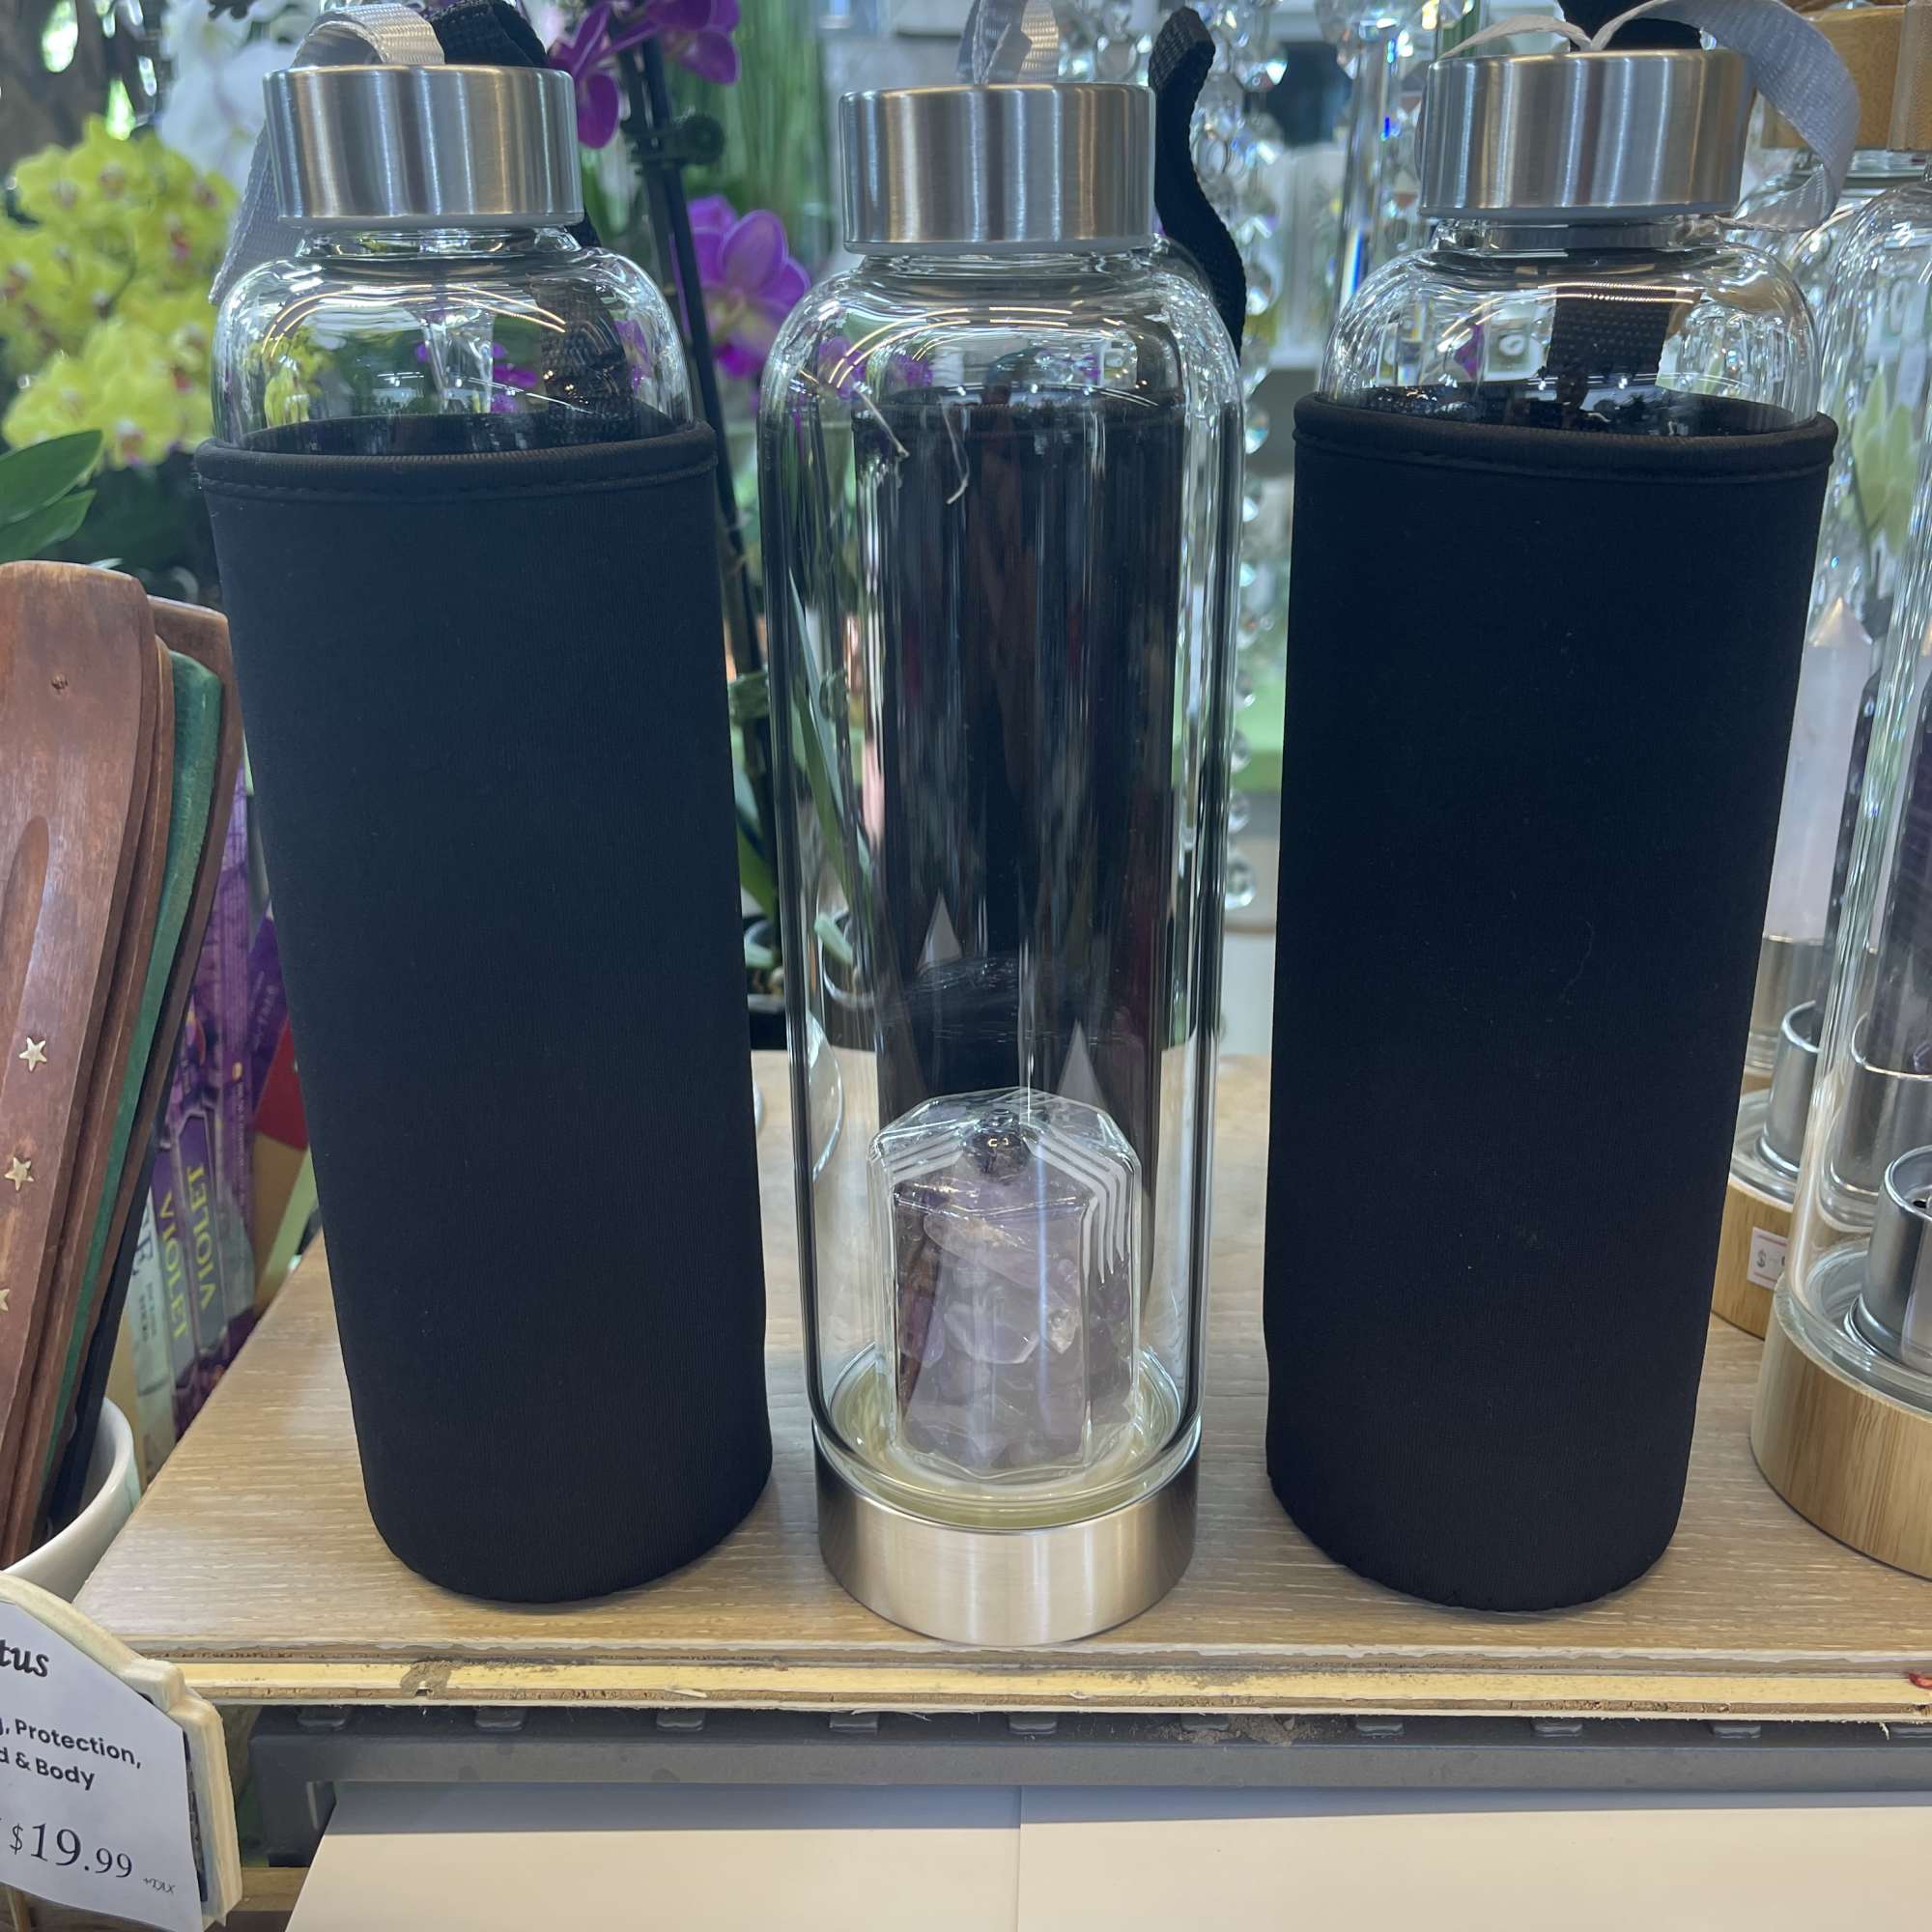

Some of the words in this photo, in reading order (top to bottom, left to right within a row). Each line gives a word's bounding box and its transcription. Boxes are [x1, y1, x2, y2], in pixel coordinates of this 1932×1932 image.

[160, 1191, 187, 1341] VIOLET
[187, 1165, 216, 1312] VIOLET
[14, 1718, 142, 1770] Protection,
[15, 1750, 32, 1772] &
[35, 1756, 96, 1791] Body
[9, 1822, 133, 1879] $19.99
